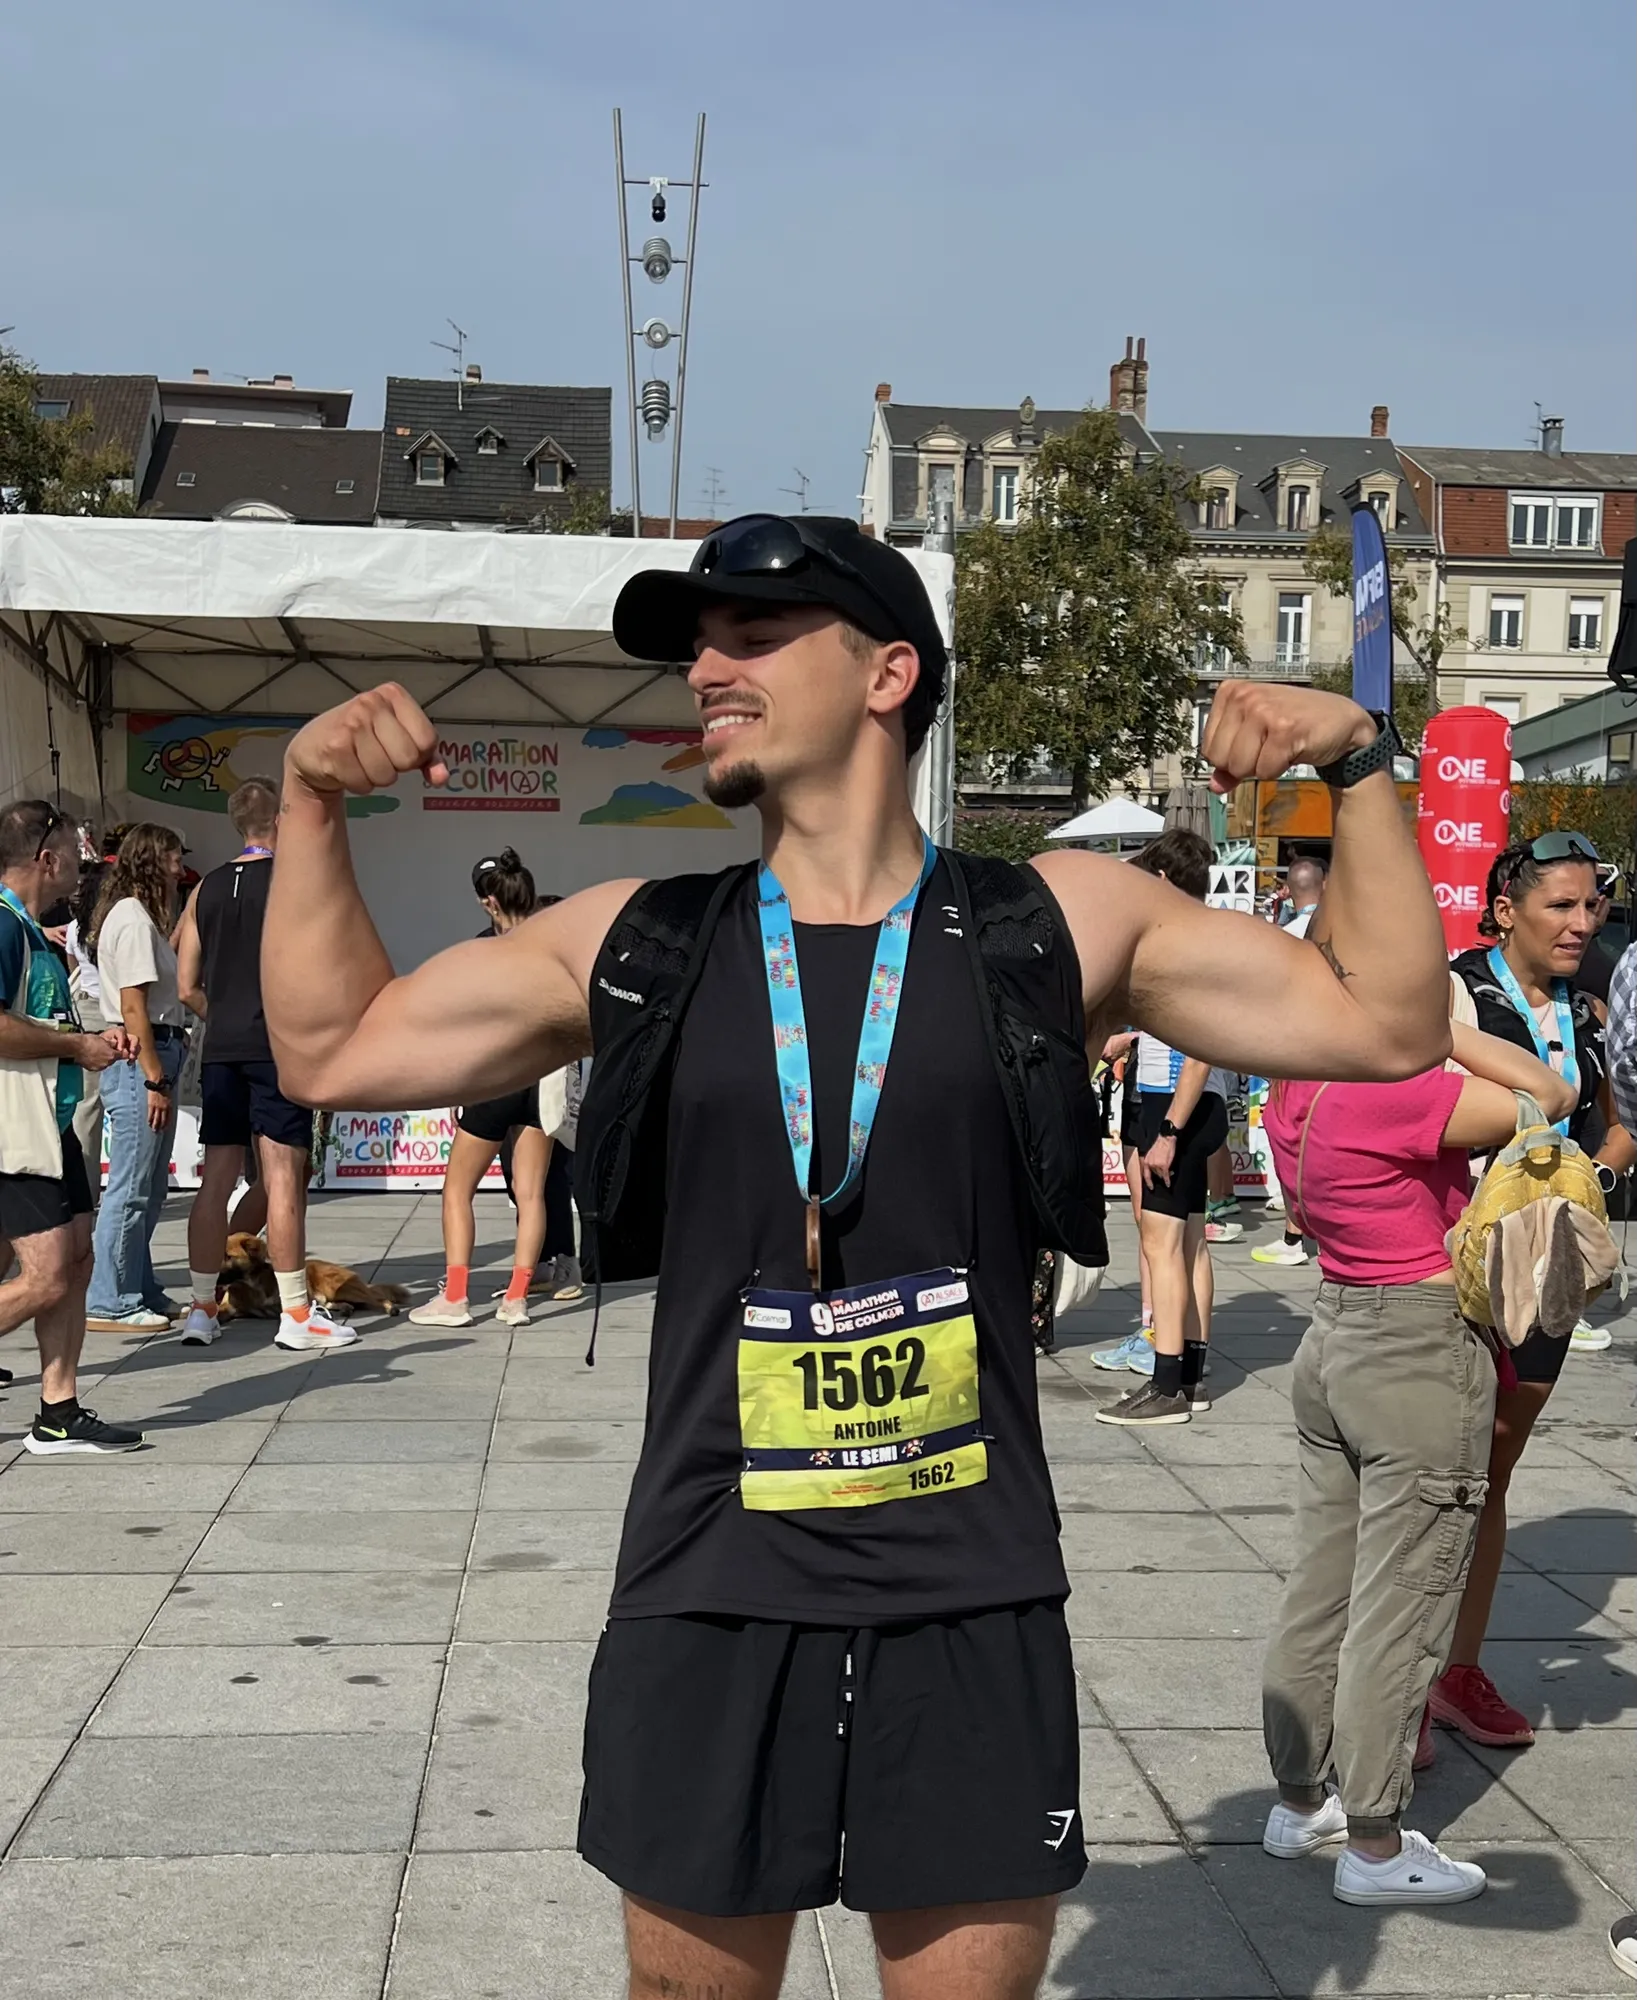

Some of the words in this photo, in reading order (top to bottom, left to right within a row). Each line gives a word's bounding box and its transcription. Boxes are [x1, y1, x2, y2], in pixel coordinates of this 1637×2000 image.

[439, 739, 558, 767] MARATHON
[1437, 756, 1487, 782] ONE
[1434, 819, 1483, 845] ONE
[598, 977, 645, 1005] SOMON
[350, 1114, 455, 1139] MARATHON
[832, 1288, 900, 1317] MARATHON
[810, 1302, 835, 1336] 9
[835, 1319, 855, 1333] DE
[854, 1305, 905, 1328] COLMAR
[793, 1337, 930, 1411] 1562
[834, 1416, 902, 1440] ANTOINE
[842, 1450, 859, 1467] LE
[861, 1446, 898, 1465] SEMI
[908, 1461, 956, 1491] 1562
